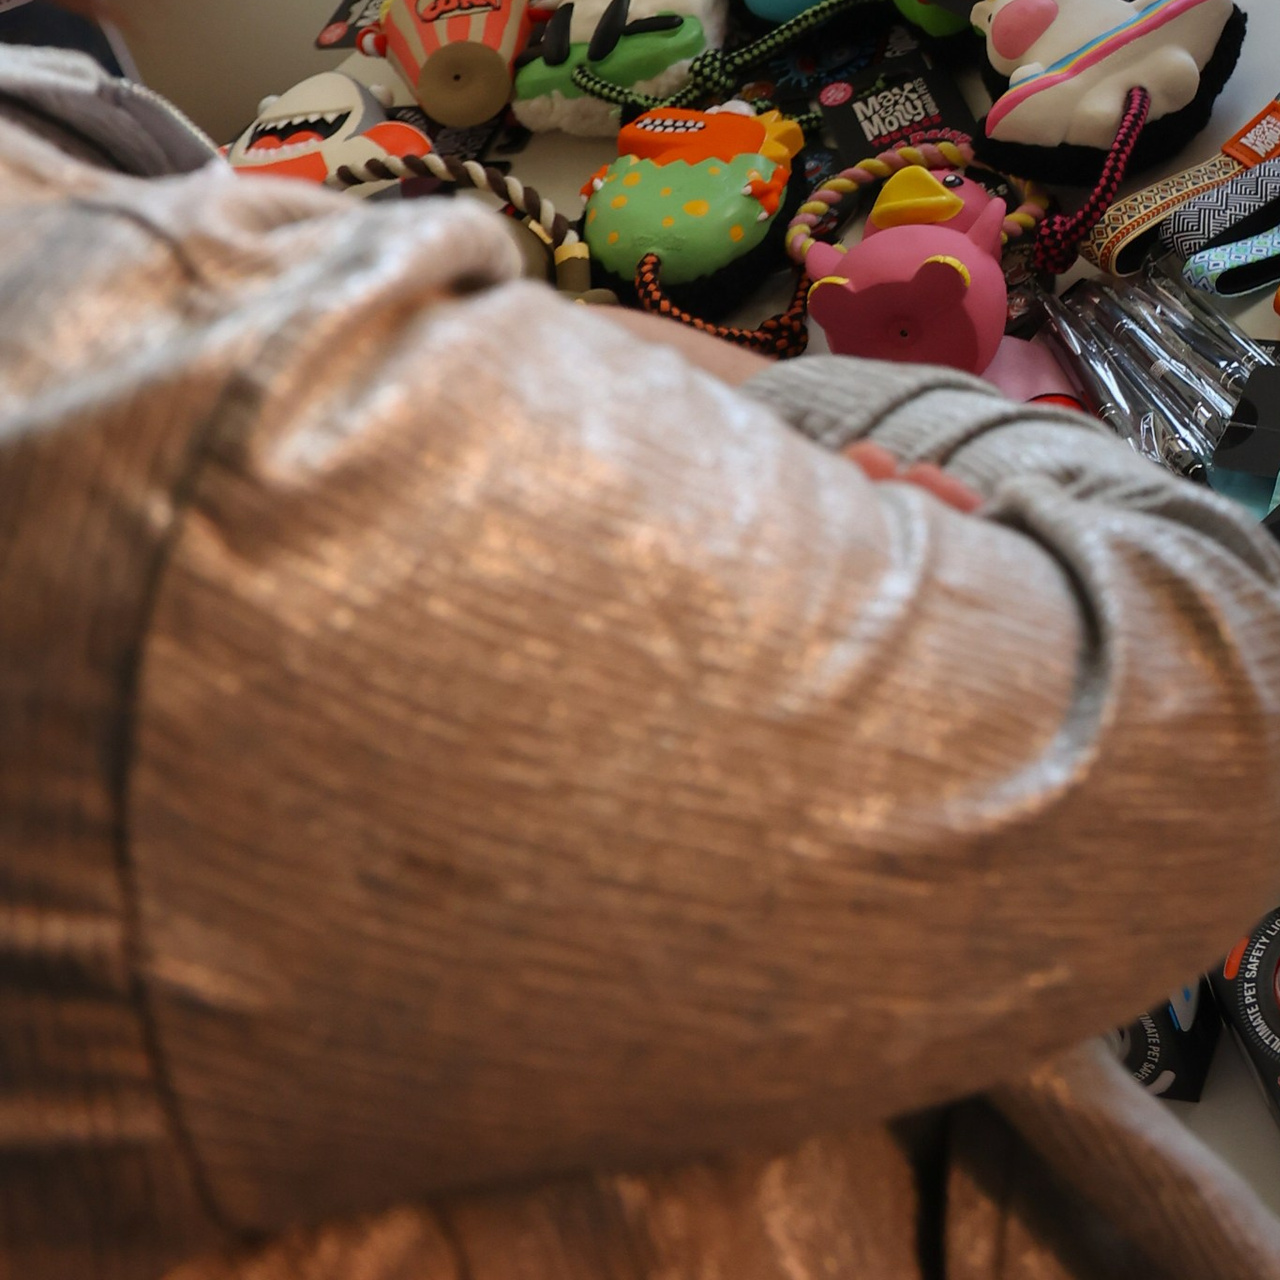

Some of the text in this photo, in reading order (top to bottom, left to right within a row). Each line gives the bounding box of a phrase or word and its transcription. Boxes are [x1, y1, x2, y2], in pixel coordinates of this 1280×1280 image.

[852, 81, 919, 123] Max
[880, 103, 895, 118] &
[860, 99, 926, 142] Molly
[1239, 118, 1274, 148] Max
[1244, 936, 1271, 979] SAFETY
[1243, 980, 1257, 1007] PET
[1146, 1044, 1160, 1063] PET
[1132, 1061, 1156, 1081] SAFE
